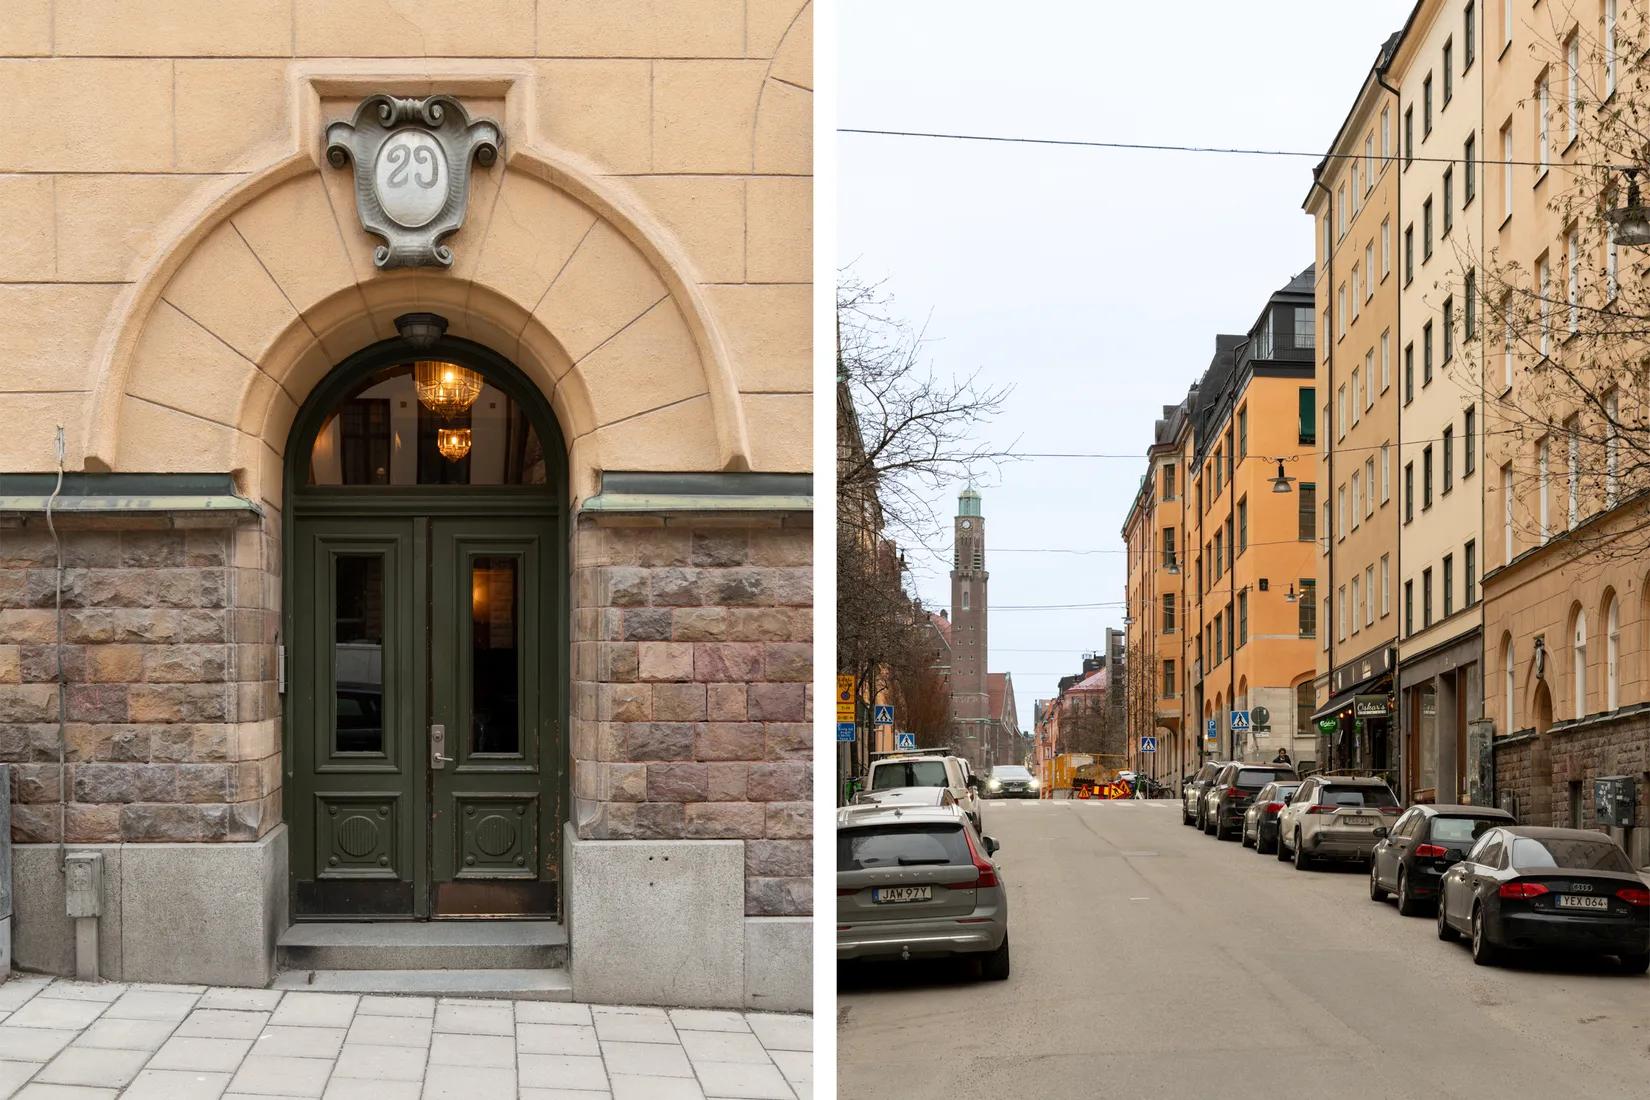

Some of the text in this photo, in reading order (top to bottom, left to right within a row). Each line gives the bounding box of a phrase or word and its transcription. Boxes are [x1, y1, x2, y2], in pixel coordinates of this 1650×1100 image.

[386, 143, 439, 190] 29
[1357, 702, 1386, 711] Oskar's
[1209, 721, 1215, 729] P
[869, 871, 934, 880] VOLVO
[882, 888, 904, 900] JAW
[905, 887, 928, 899] 97Y
[1564, 896, 1604, 908] YEX 064
